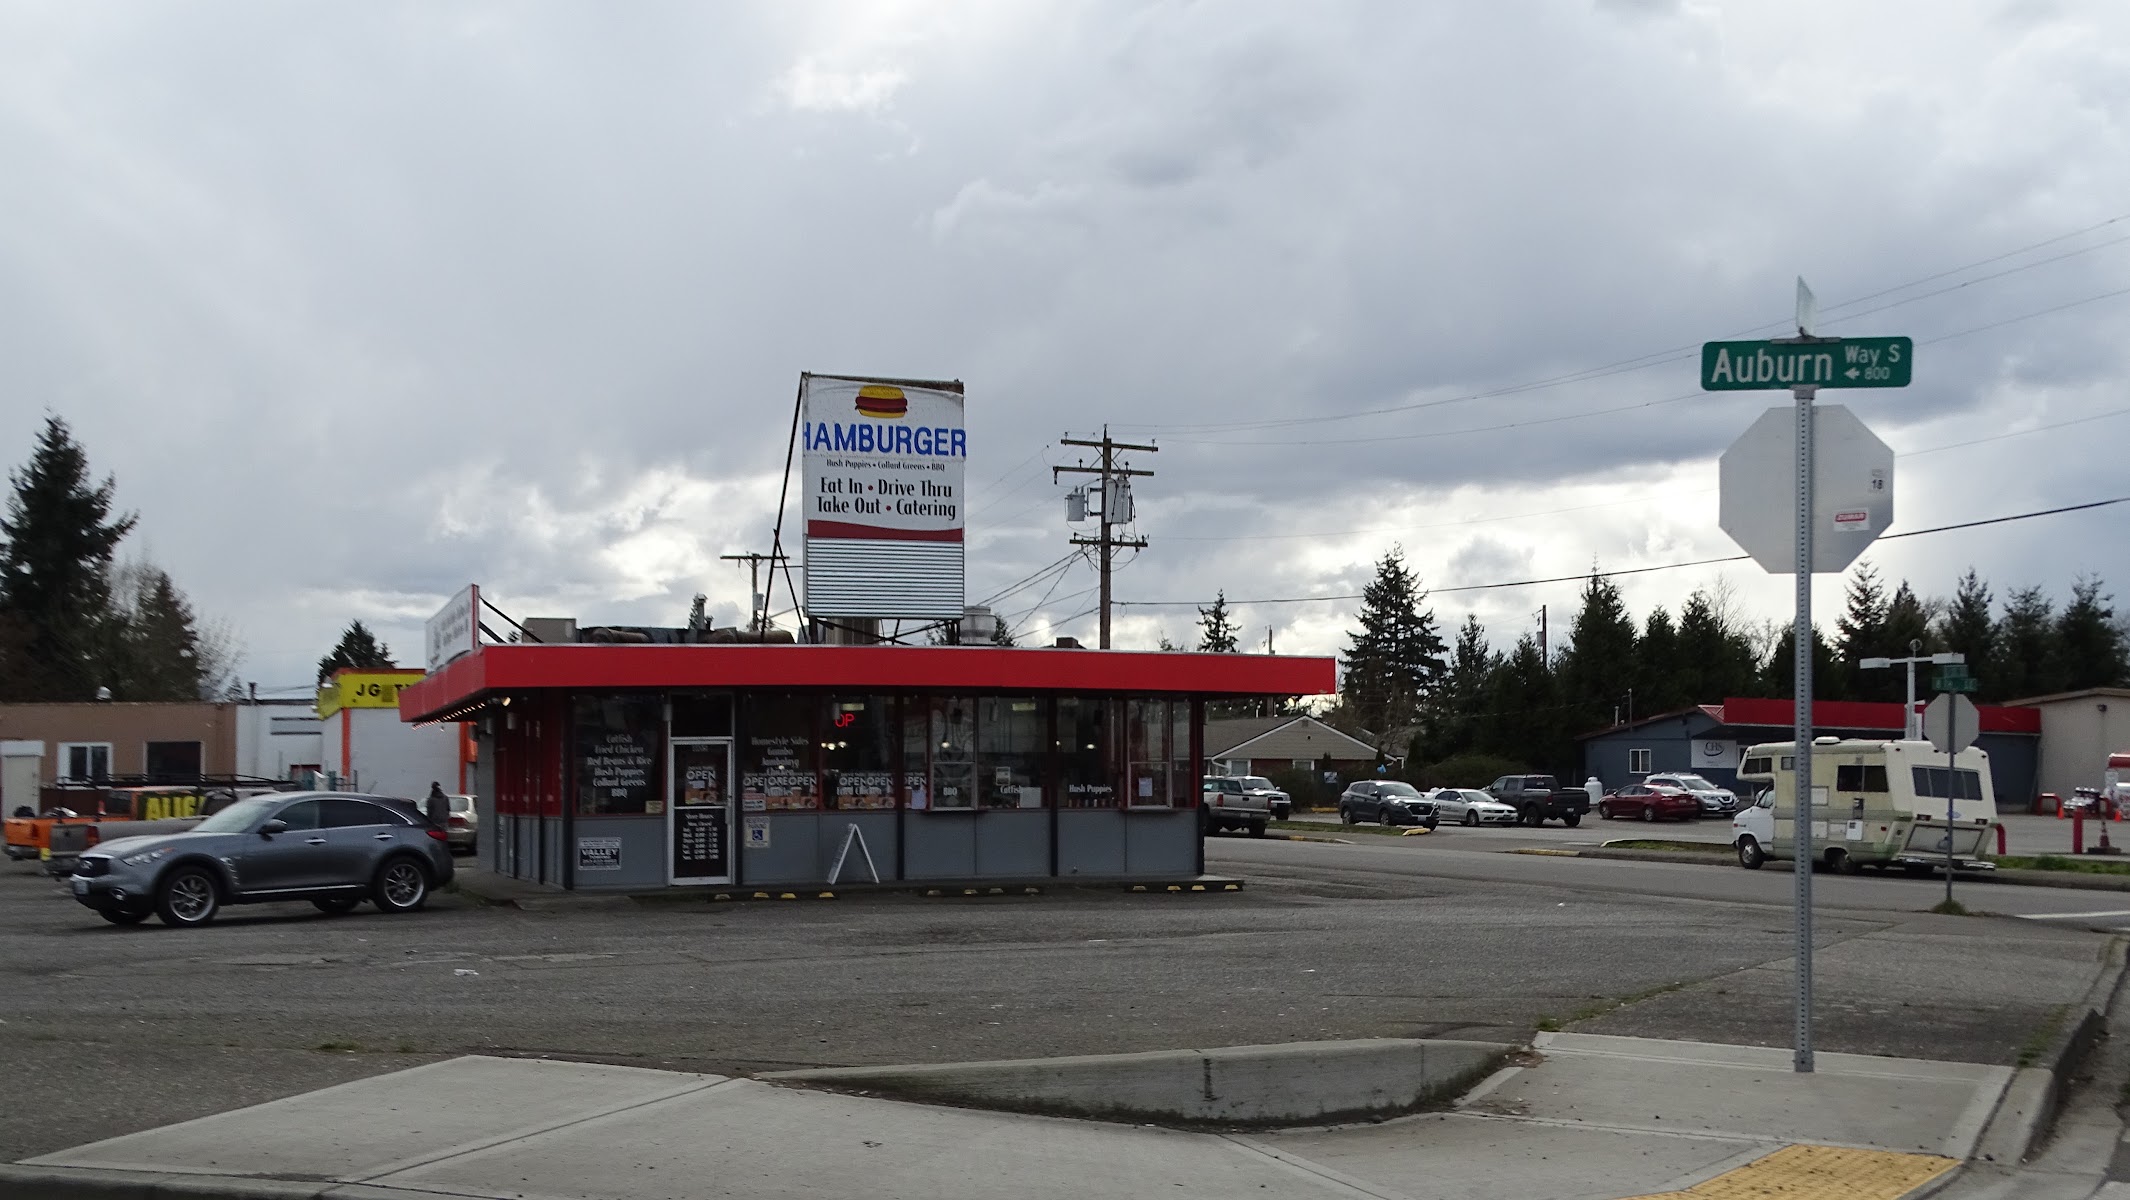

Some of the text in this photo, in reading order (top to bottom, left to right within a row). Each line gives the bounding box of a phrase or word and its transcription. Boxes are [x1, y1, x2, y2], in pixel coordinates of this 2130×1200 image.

[1711, 344, 1901, 384] Auburn Way S
[1865, 367, 1890, 380] 800
[804, 422, 967, 458] HAMBURGER
[827, 459, 945, 472] Hush Puppies Collard Greens BBQ
[820, 477, 952, 498] Eat In Drive Thru
[816, 496, 956, 521] Take Out Catering
[614, 744, 644, 754] Chicken
[686, 770, 716, 780] OPEN
[788, 777, 817, 786] OPEN
[839, 777, 866, 786] OPEN
[867, 777, 893, 786] OPEN
[942, 787, 957, 796] BBQ
[1069, 784, 1113, 795] Hush Puppies
